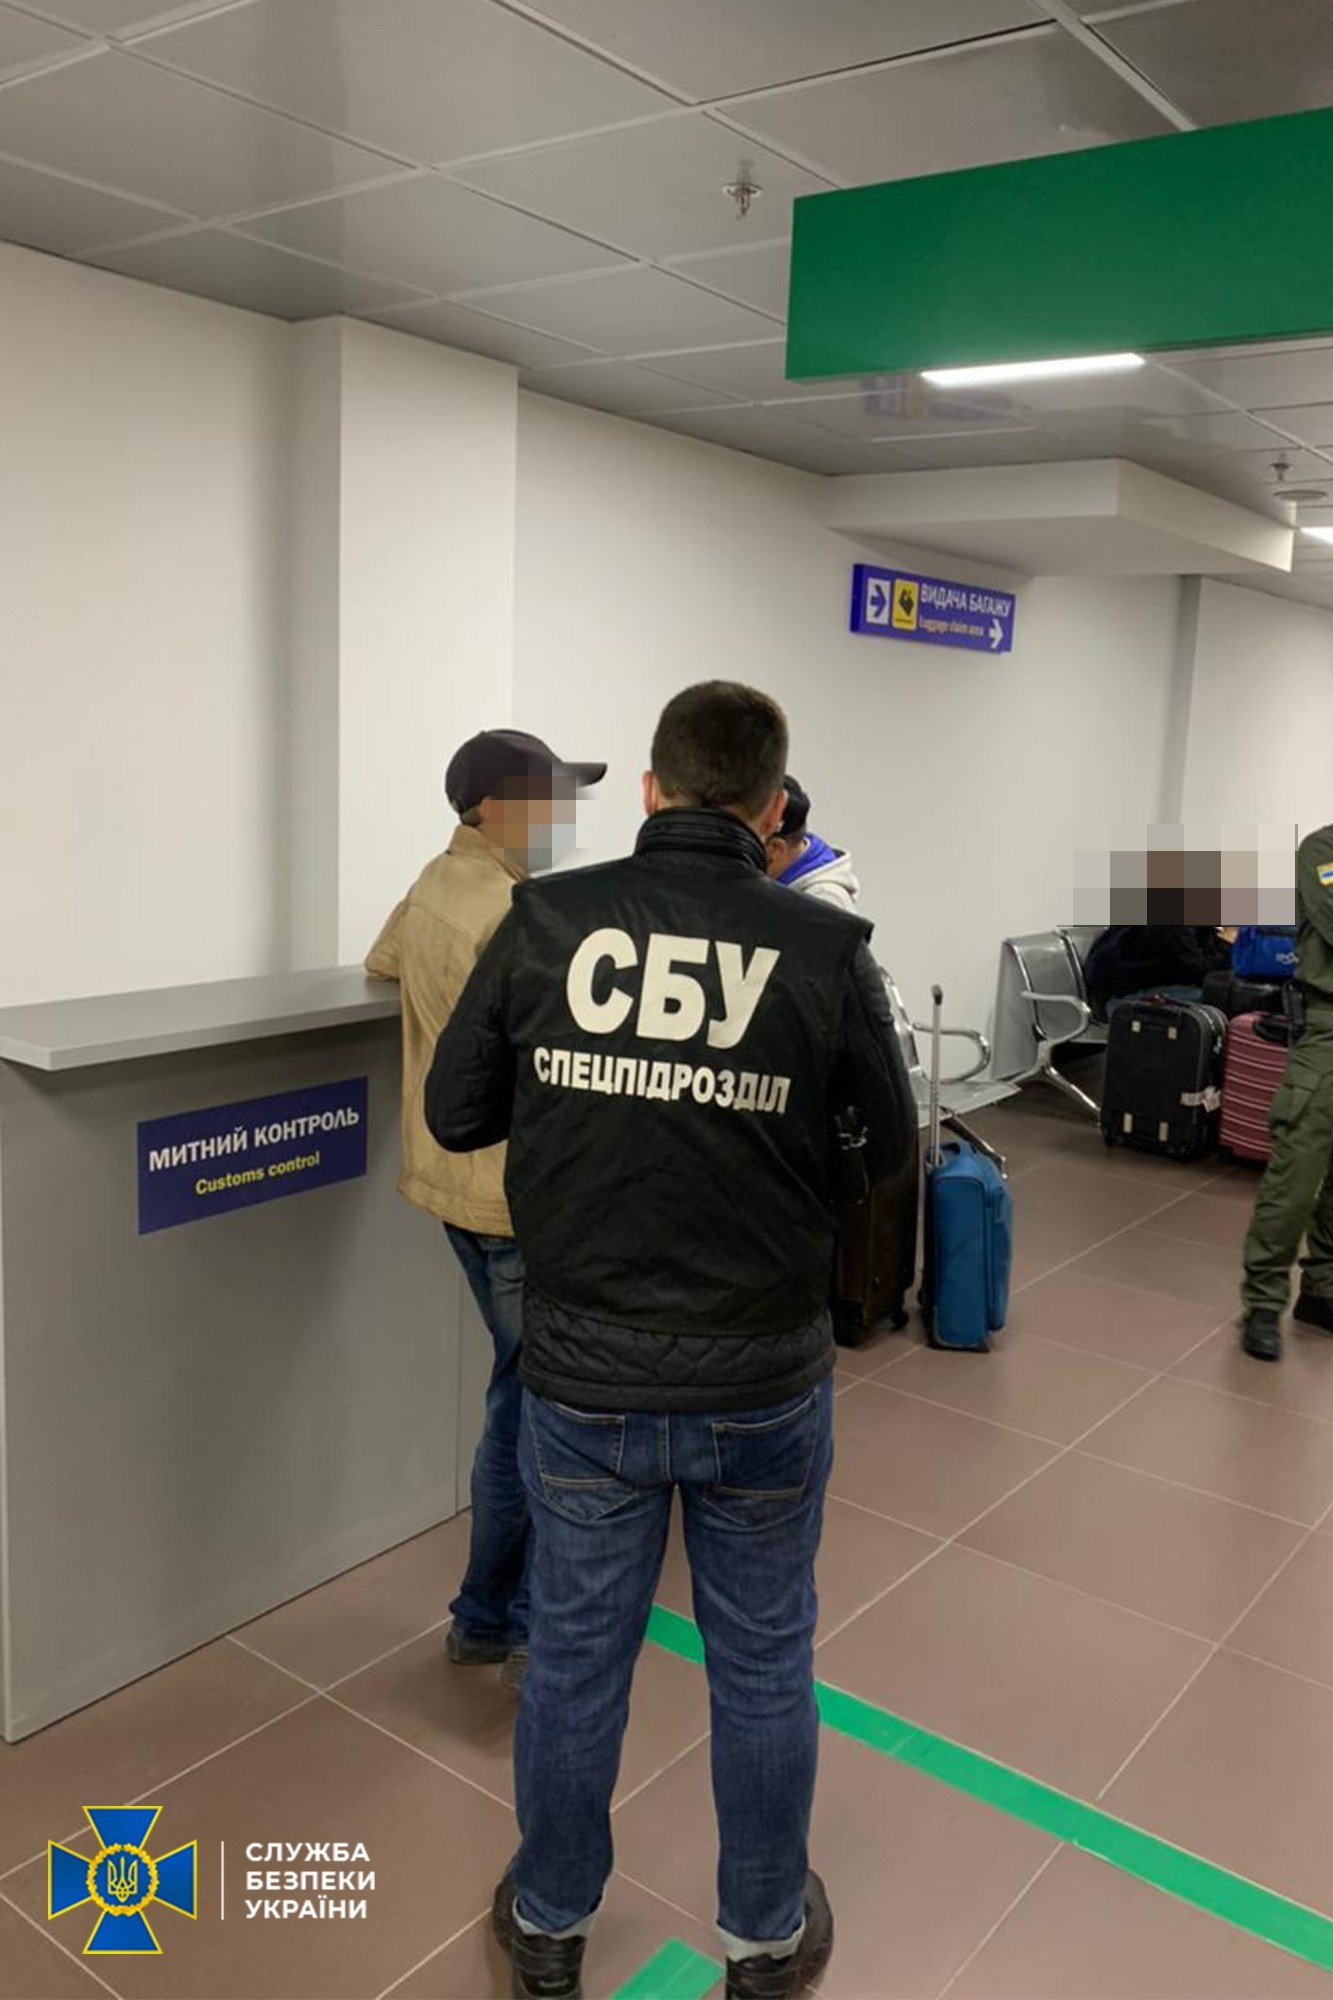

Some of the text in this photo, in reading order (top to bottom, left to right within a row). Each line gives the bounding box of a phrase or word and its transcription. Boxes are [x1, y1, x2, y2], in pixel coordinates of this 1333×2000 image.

[921, 583, 1012, 617] ВИДАЧА БАГАЖУ
[566, 927, 781, 1049] СБУ
[533, 1046, 792, 1114] СПЕЦПІДРОЗДІЛ
[149, 1107, 360, 1172] МИТНИЙ КОНТРОЛЬ
[195, 1151, 320, 1195] Customs control
